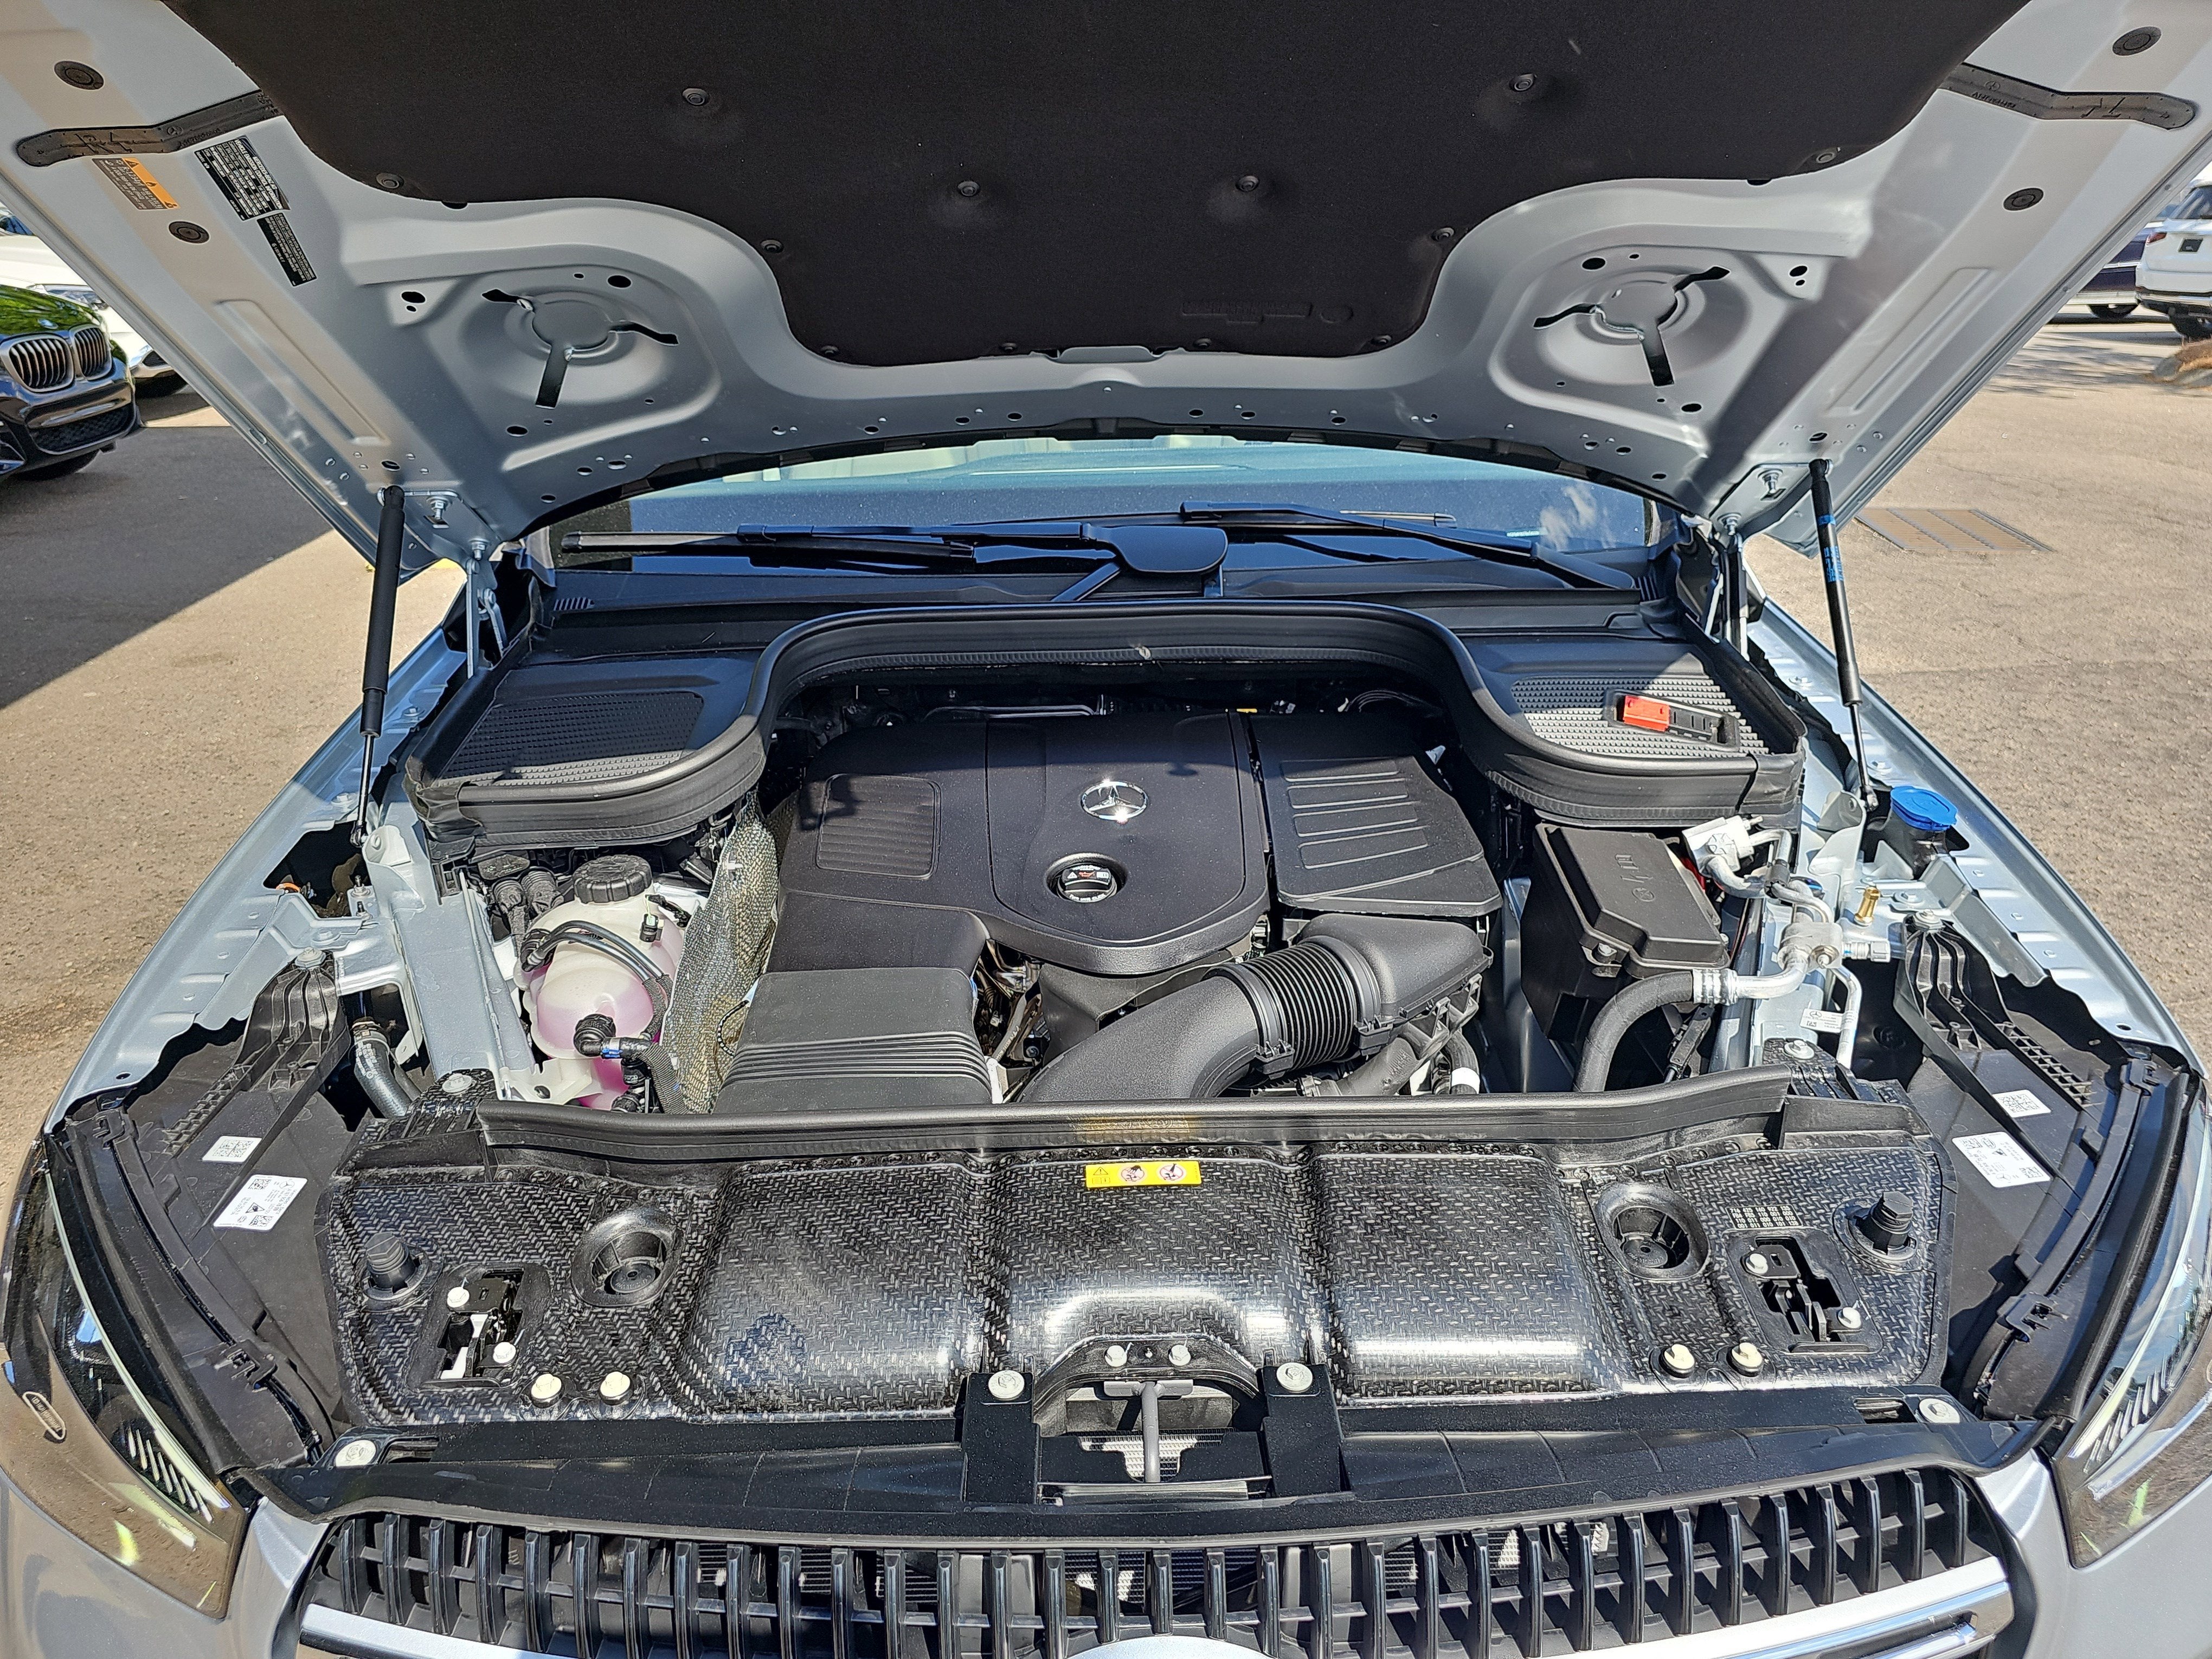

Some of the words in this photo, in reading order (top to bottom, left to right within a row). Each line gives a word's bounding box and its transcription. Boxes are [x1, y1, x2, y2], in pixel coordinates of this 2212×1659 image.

[120, 166, 145, 186] R-1234yf
[234, 139, 248, 154] VEHICLE
[243, 153, 258, 170] EMISSION
[254, 170, 268, 185] CONTROL
[264, 185, 283, 209] INFORMATION
[252, 156, 274, 184] MERCEDES-BENZ
